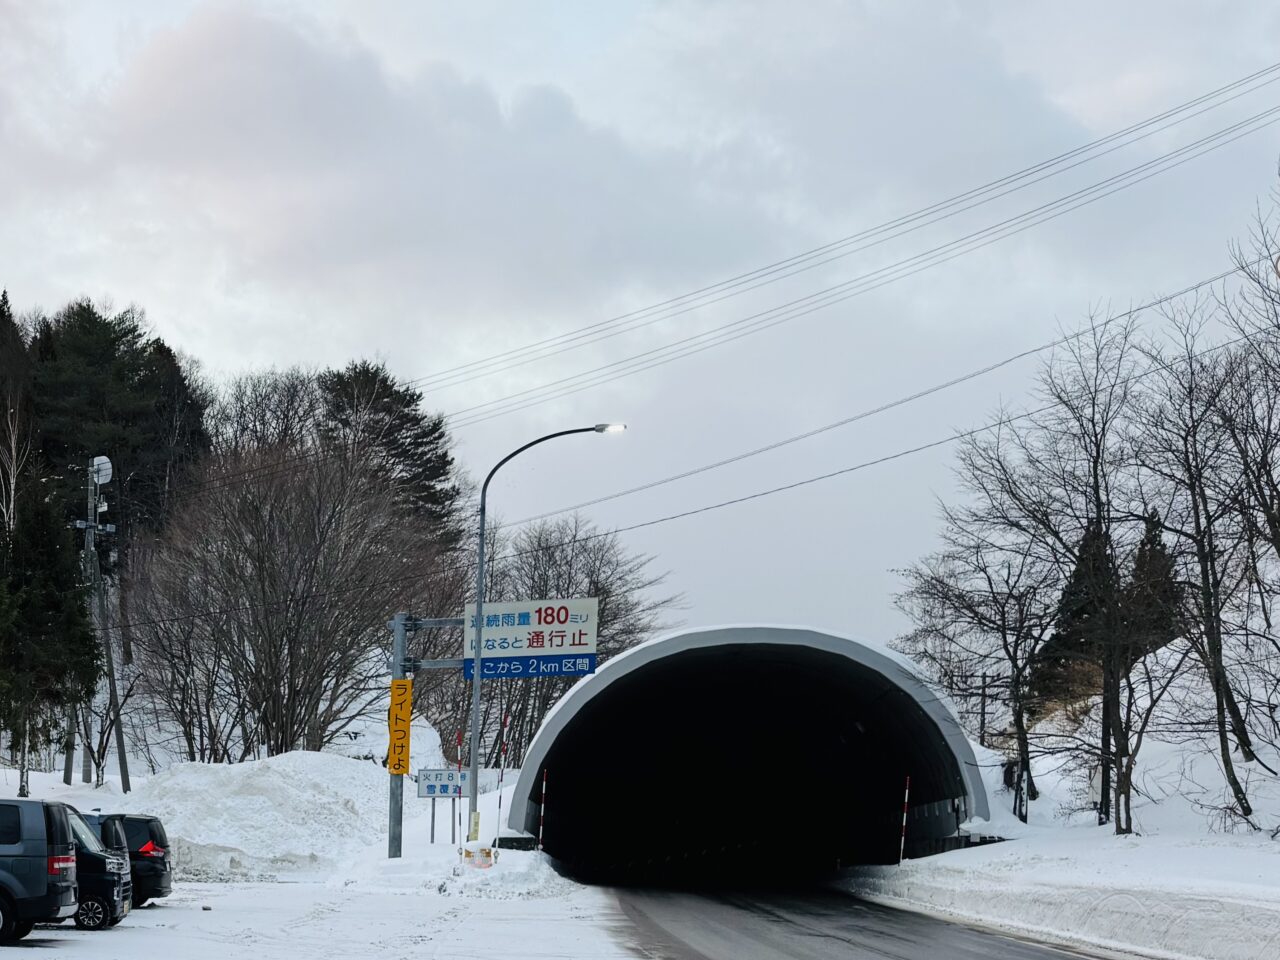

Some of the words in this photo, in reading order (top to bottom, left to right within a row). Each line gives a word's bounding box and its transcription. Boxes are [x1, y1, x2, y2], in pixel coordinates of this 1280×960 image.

[393, 684, 407, 770] ライトつけよ
